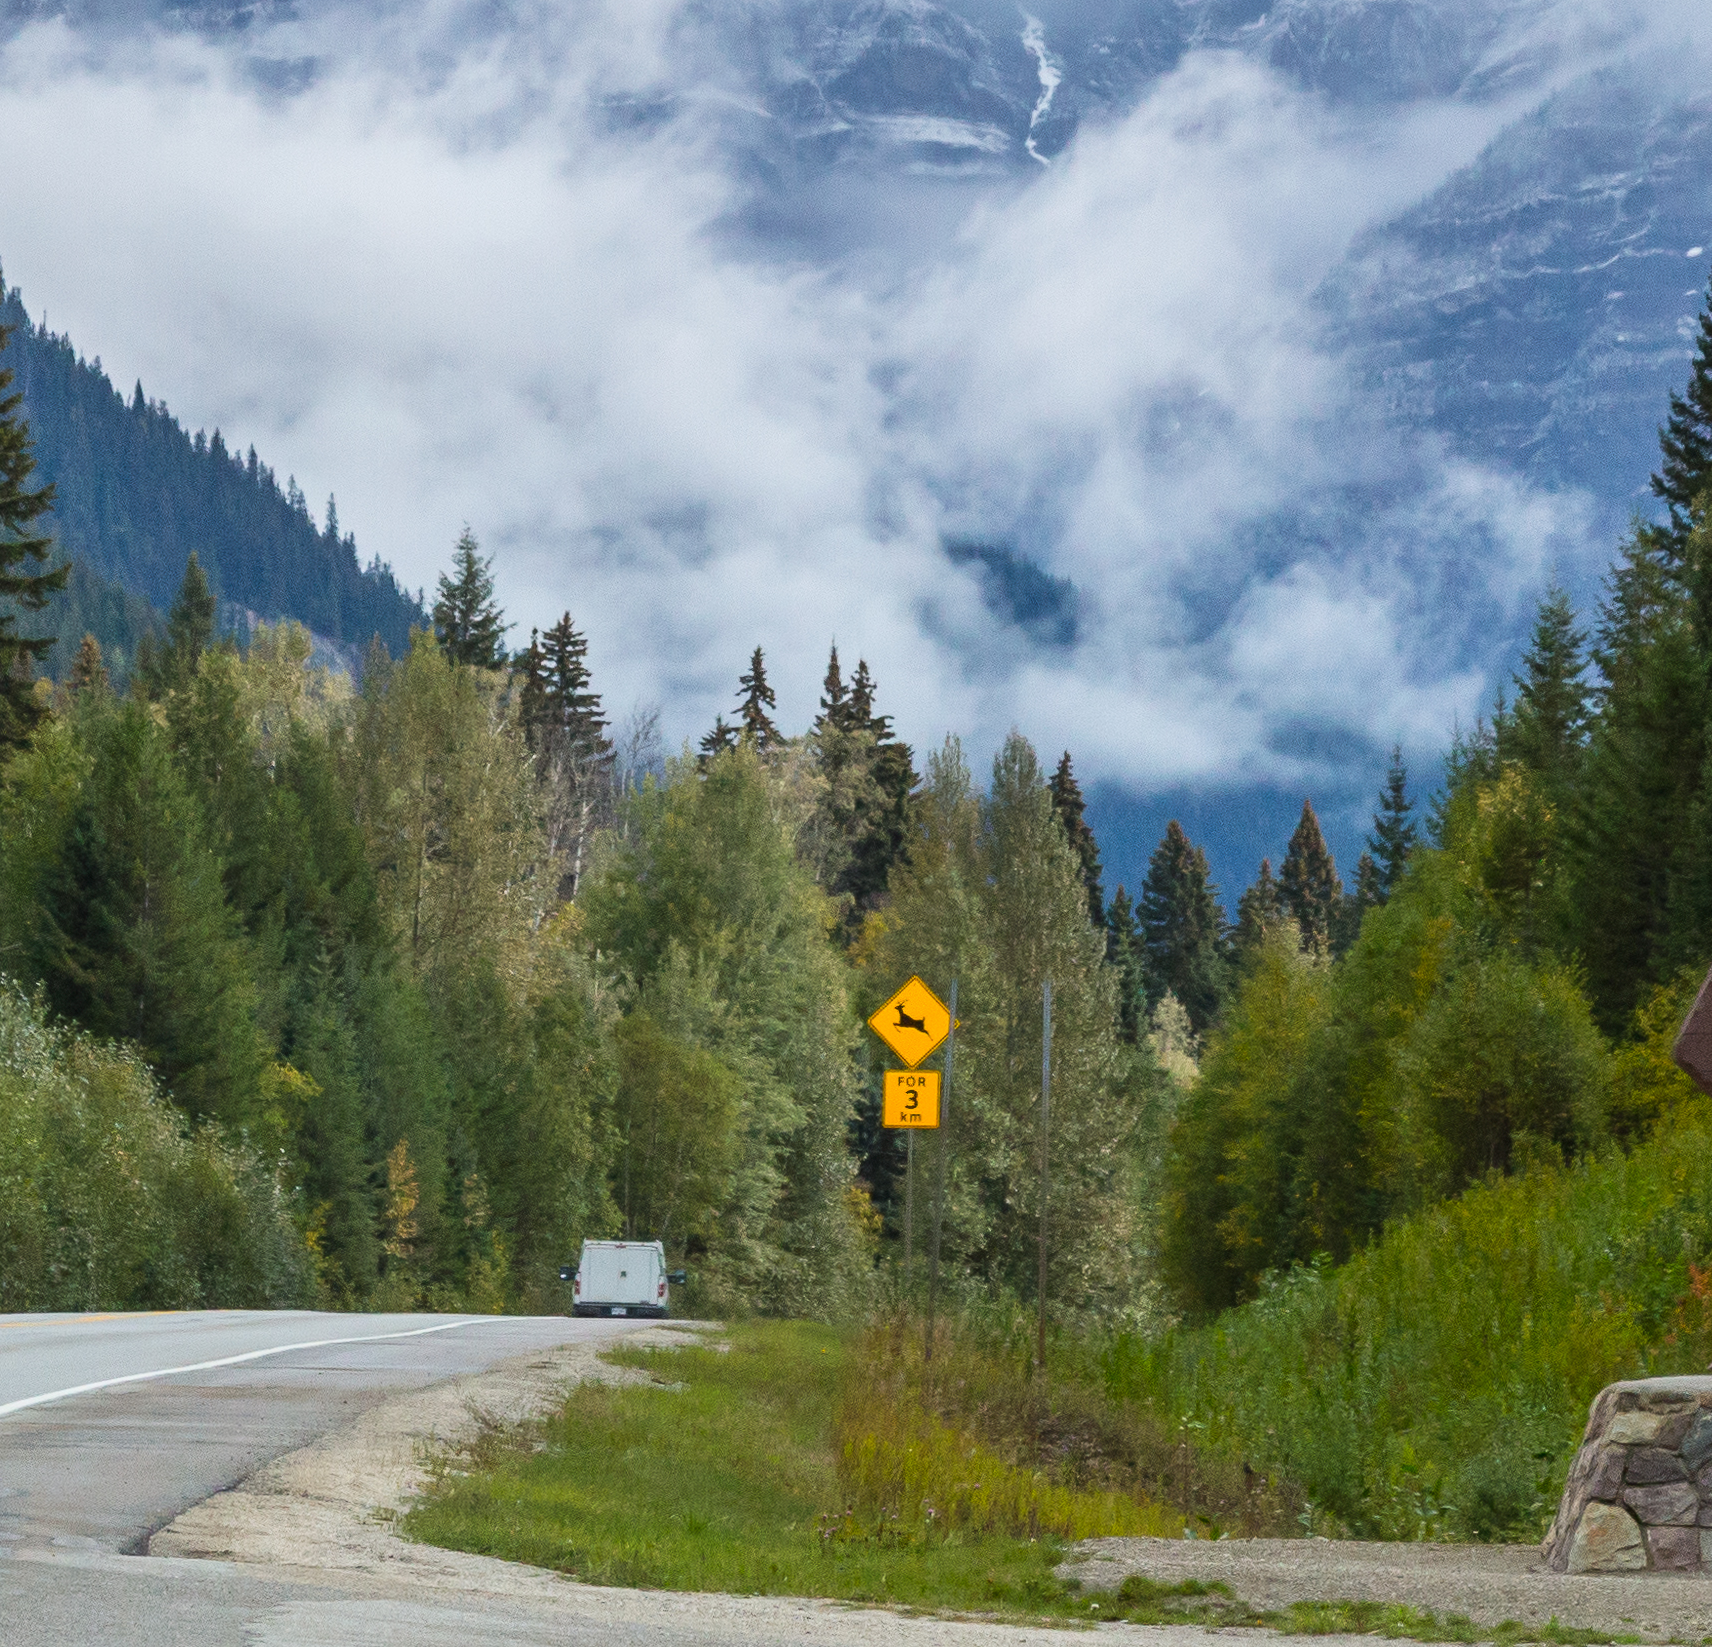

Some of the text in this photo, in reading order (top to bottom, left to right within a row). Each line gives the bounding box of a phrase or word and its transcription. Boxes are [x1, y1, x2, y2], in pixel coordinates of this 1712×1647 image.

[897, 1075, 926, 1087] FOR
[904, 1089, 919, 1110] 3
[899, 1111, 922, 1123] km
